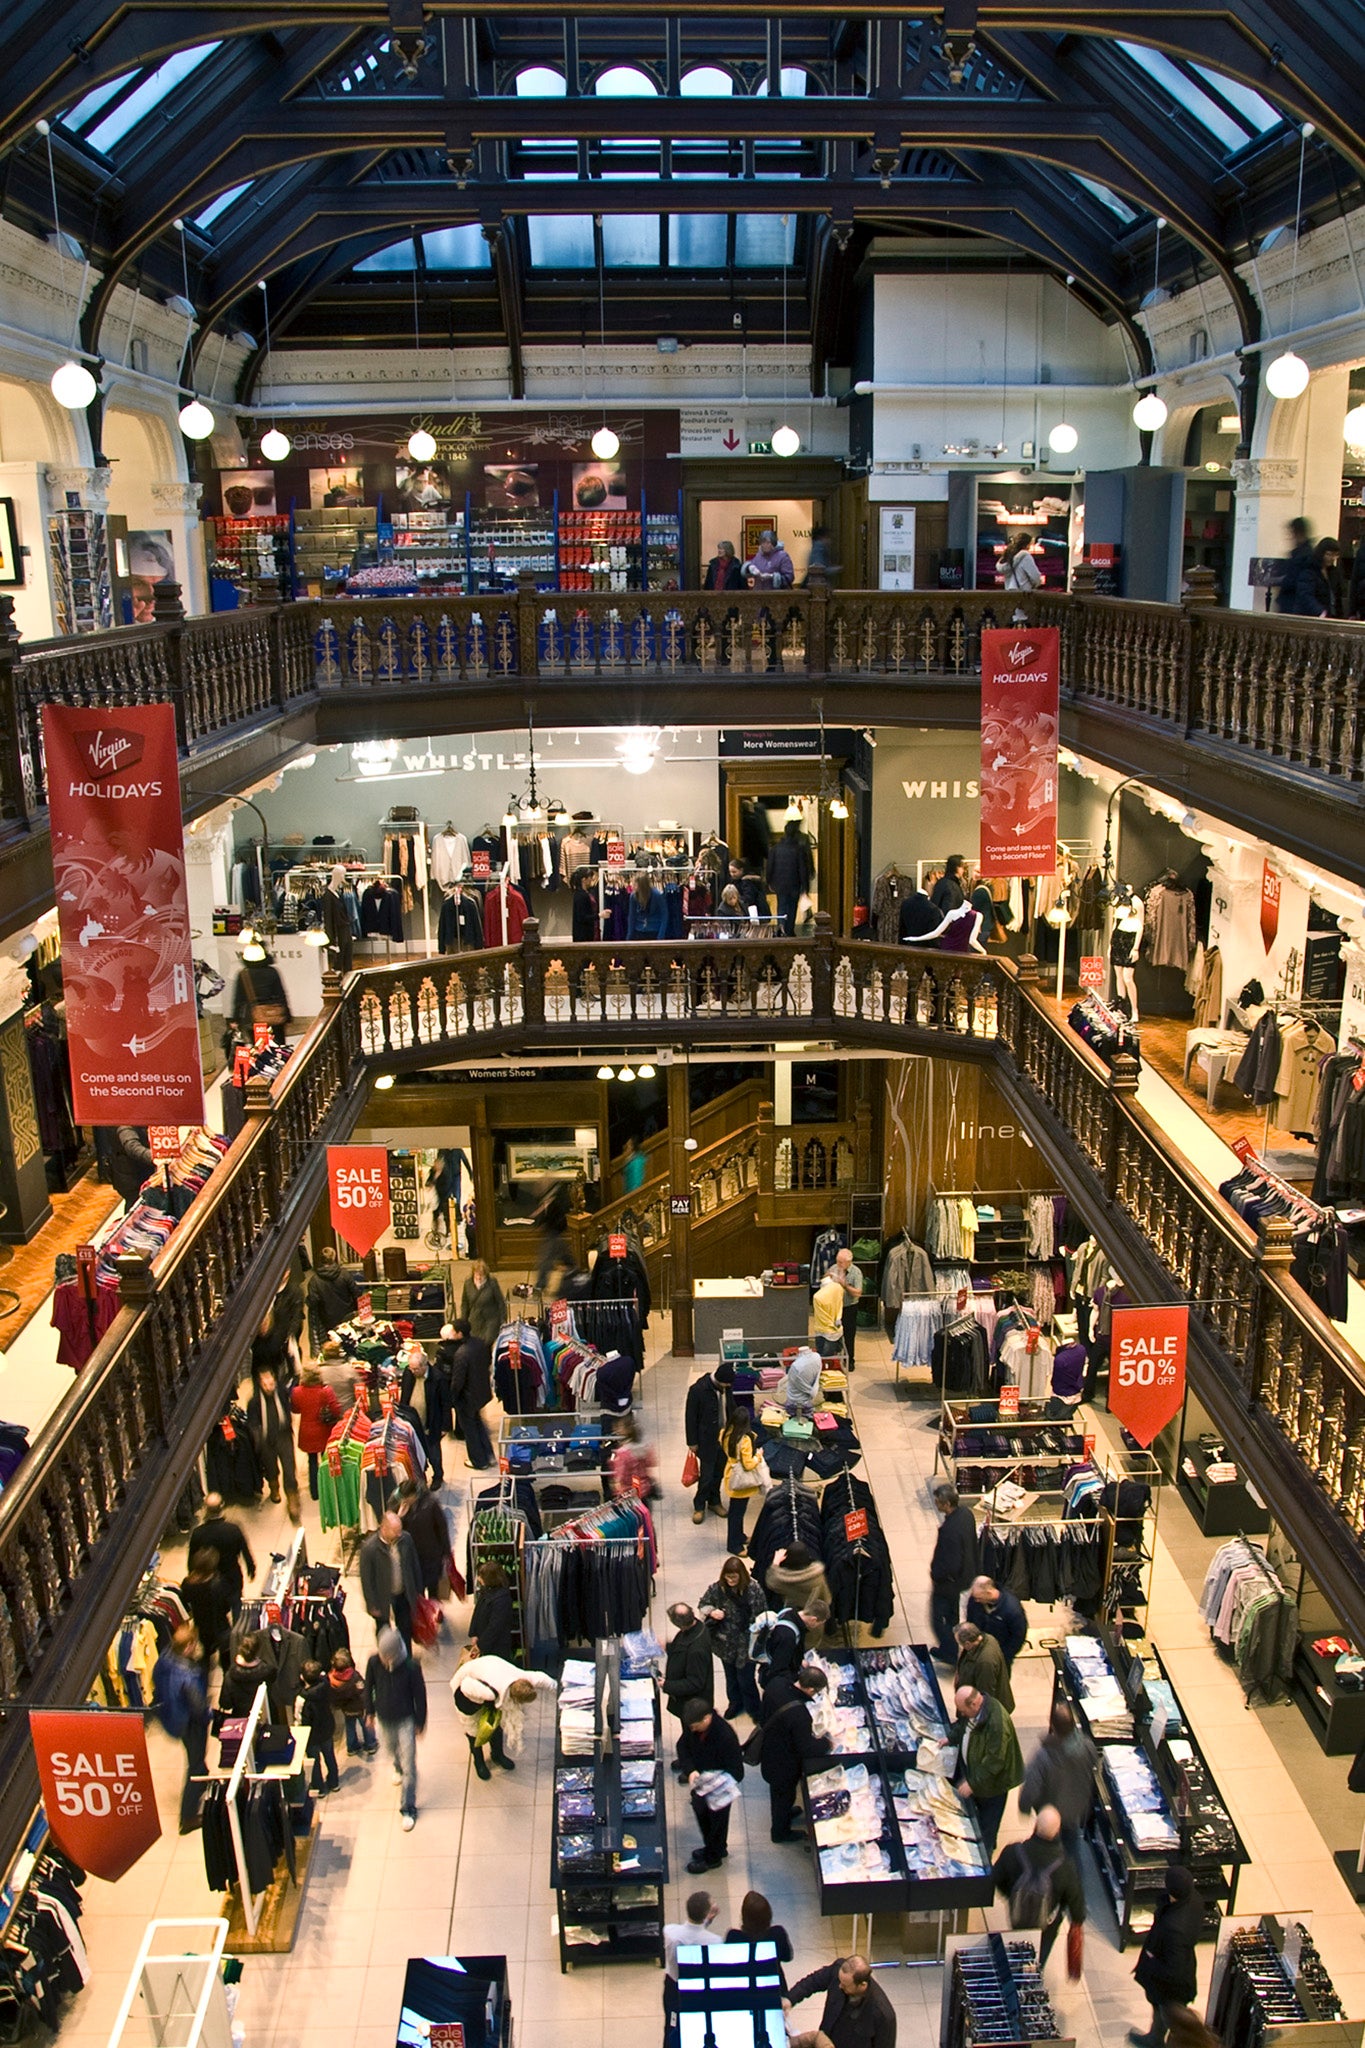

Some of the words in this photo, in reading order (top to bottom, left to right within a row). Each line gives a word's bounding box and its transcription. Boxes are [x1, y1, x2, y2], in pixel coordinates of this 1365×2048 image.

[448, 452, 467, 460] 1845
[1008, 642, 1035, 666] Virgin
[993, 672, 1048, 684] HOLIDAYS
[88, 730, 132, 770] Virgin
[743, 740, 764, 748] More
[764, 740, 818, 748] Womenswear
[69, 781, 162, 799] HOLIDAYS
[902, 780, 980, 799] WHIS
[986, 845, 1005, 854] Come
[1006, 844, 1020, 852] and
[990, 852, 1002, 860] the
[1002, 852, 1028, 860] Second
[1029, 852, 1046, 860] Floor
[235, 950, 303, 958] WTLES
[80, 1072, 115, 1084] Come
[116, 1072, 139, 1082] and
[140, 1074, 160, 1083] see
[162, 1074, 176, 1084] us
[176, 1074, 192, 1084] on
[469, 1070, 508, 1078] Womens
[508, 1069, 536, 1077] Shoes
[806, 1074, 816, 1085] M
[90, 1086, 110, 1097] the
[110, 1086, 154, 1096] Second
[156, 1086, 184, 1096] Floor
[150, 1126, 178, 1136] sale
[961, 1122, 1023, 1140] line
[336, 1168, 382, 1184] SALE
[338, 1186, 383, 1208] 50%
[1120, 1336, 1178, 1356] SALE
[1118, 1358, 1176, 1386] 50%
[1156, 1376, 1176, 1386] OFF
[50, 1752, 138, 1778] SALE
[55, 1782, 142, 1816] 50%
[116, 1804, 144, 1816] OFF
[431, 2026, 462, 2038] sale
